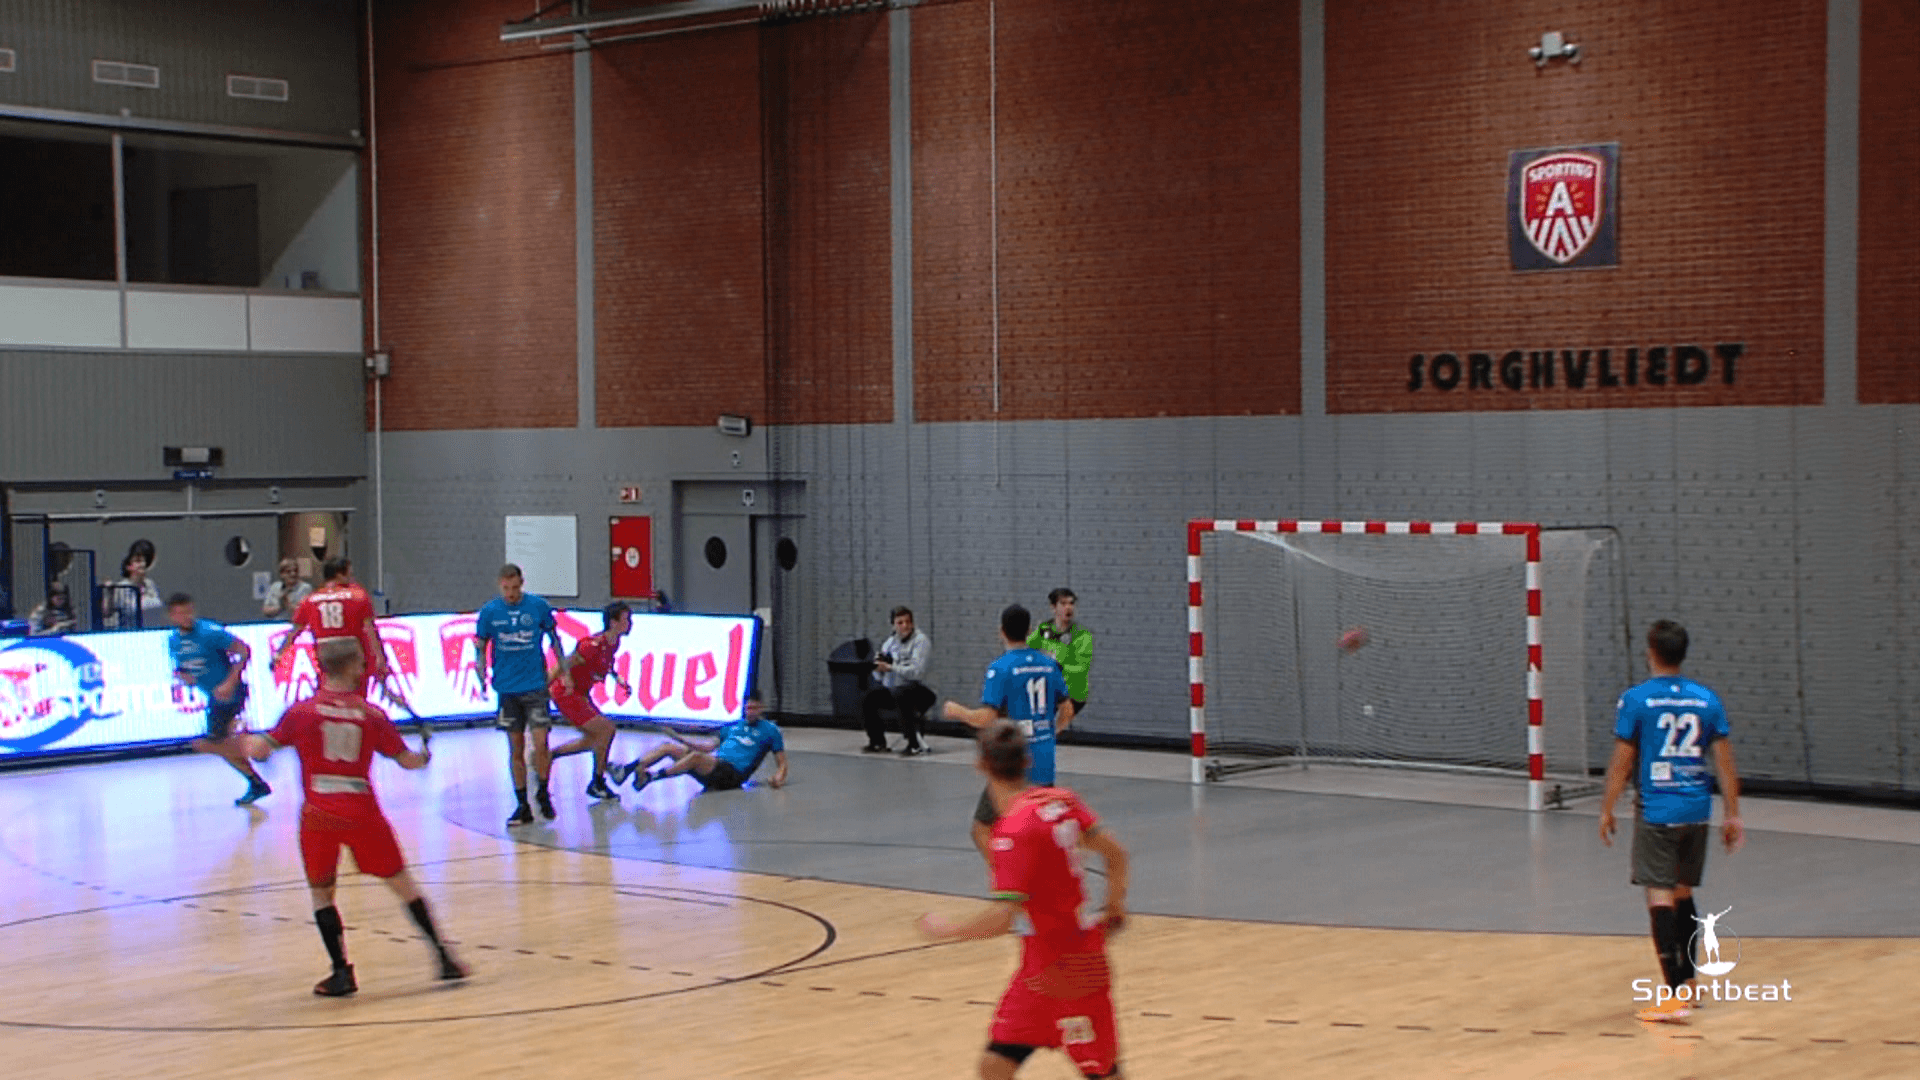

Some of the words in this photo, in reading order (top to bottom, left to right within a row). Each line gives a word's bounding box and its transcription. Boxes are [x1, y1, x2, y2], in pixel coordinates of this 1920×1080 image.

[1529, 162, 1595, 183] SPORTING
[1407, 342, 1746, 392] SORGHVLIEDT
[318, 601, 344, 629] 18
[1026, 676, 1047, 716] 11
[1656, 711, 1702, 757] 22
